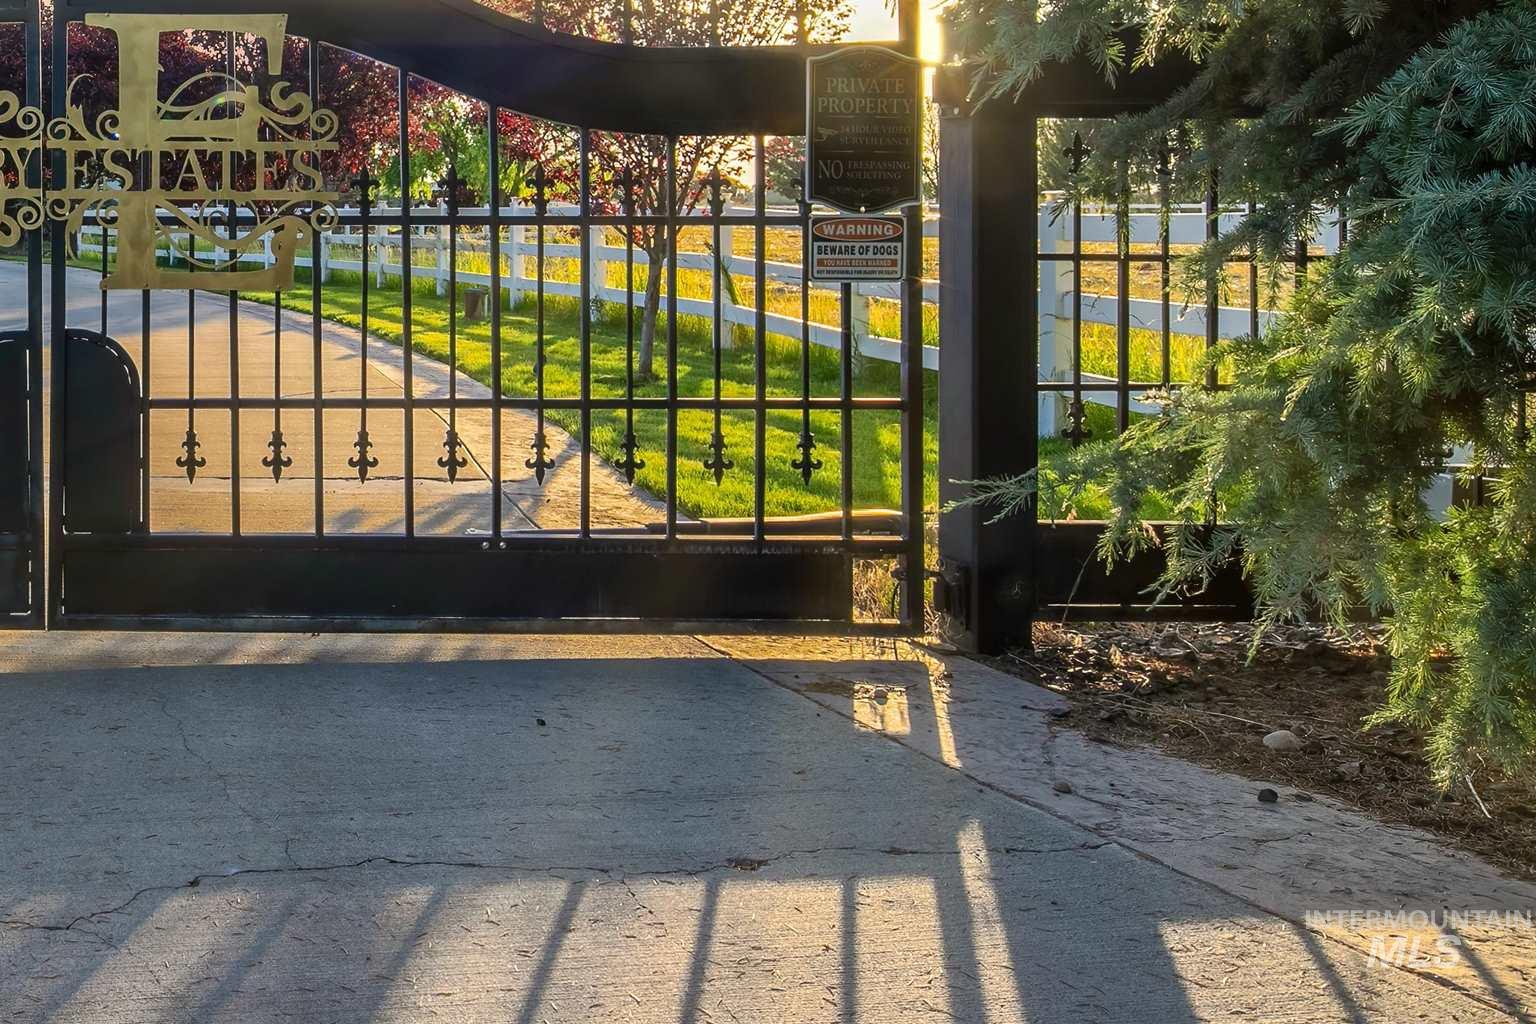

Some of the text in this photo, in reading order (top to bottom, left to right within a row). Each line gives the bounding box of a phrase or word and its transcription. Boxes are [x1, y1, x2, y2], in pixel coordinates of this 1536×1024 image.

[825, 78, 904, 93] PRIVATE
[817, 97, 912, 113] PROPERTY
[840, 136, 912, 145] SURVEILLANCE
[66, 148, 324, 193] ESTATES
[818, 160, 843, 179] NO
[848, 160, 910, 170] TRESPASSING
[823, 224, 894, 235] WARNING
[817, 245, 898, 255] BEWARE OF DOGS
